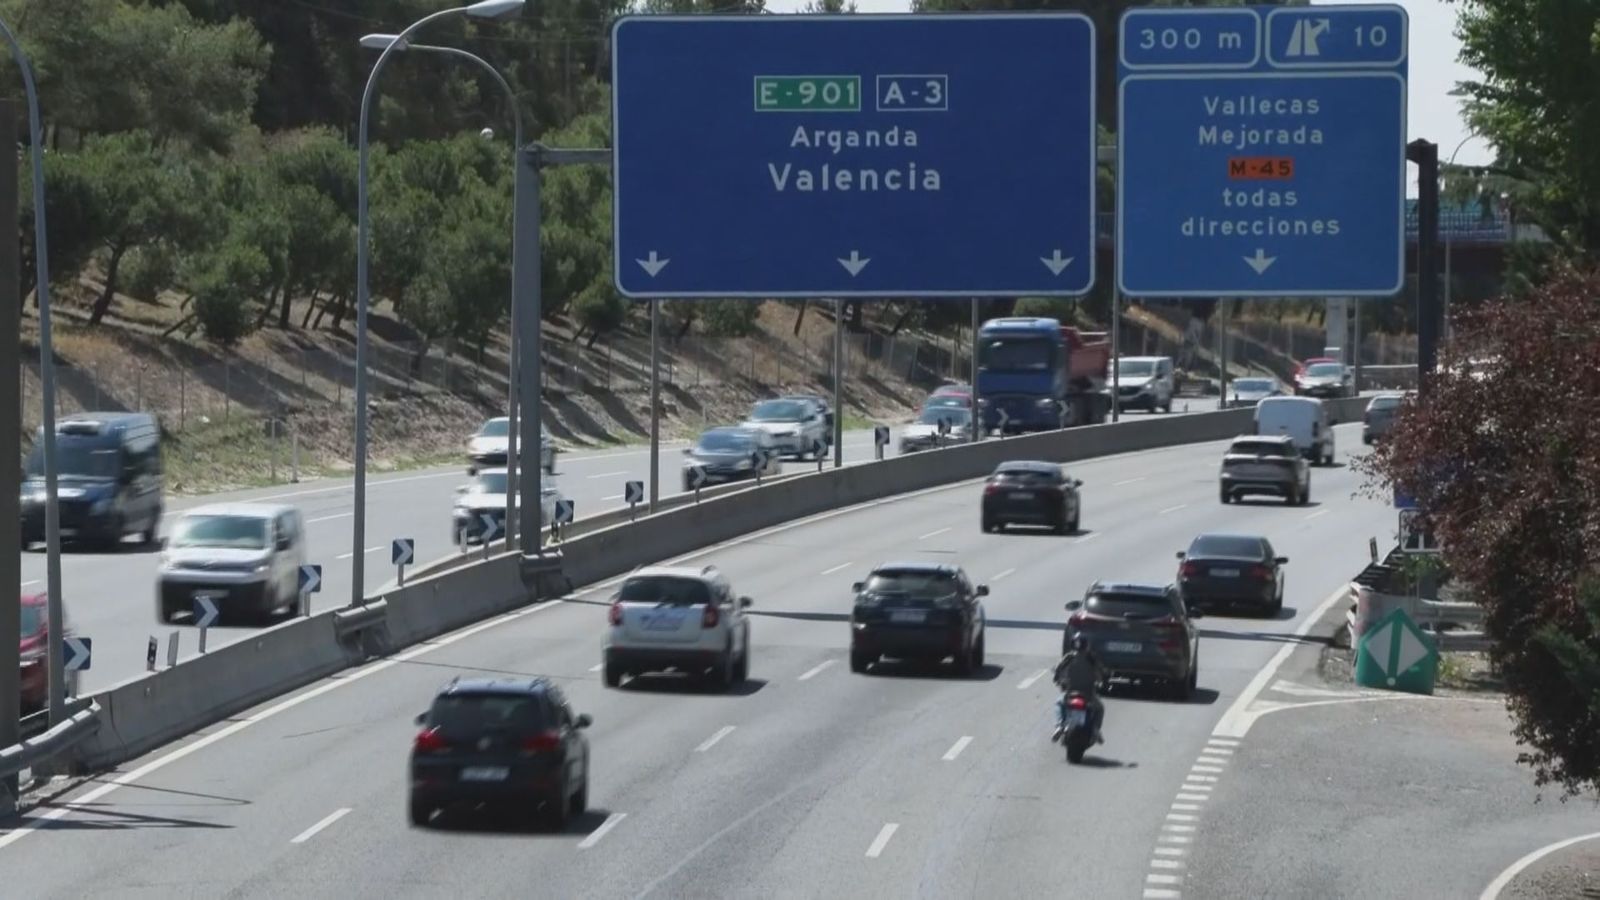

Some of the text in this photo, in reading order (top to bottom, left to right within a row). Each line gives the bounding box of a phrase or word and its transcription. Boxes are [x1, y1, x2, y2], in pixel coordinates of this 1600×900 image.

[1139, 28, 1242, 50] 300 m
[1354, 25, 1387, 47] 10
[760, 81, 855, 106] E-901
[883, 80, 942, 105] A-3
[1203, 96, 1320, 116] Vallecas
[790, 126, 918, 154] Arganda
[1198, 124, 1323, 149] Mejorada
[767, 162, 941, 191] Valencia
[1231, 161, 1291, 177] M-45
[1222, 187, 1298, 207] todas
[1181, 216, 1340, 236] direcciones
